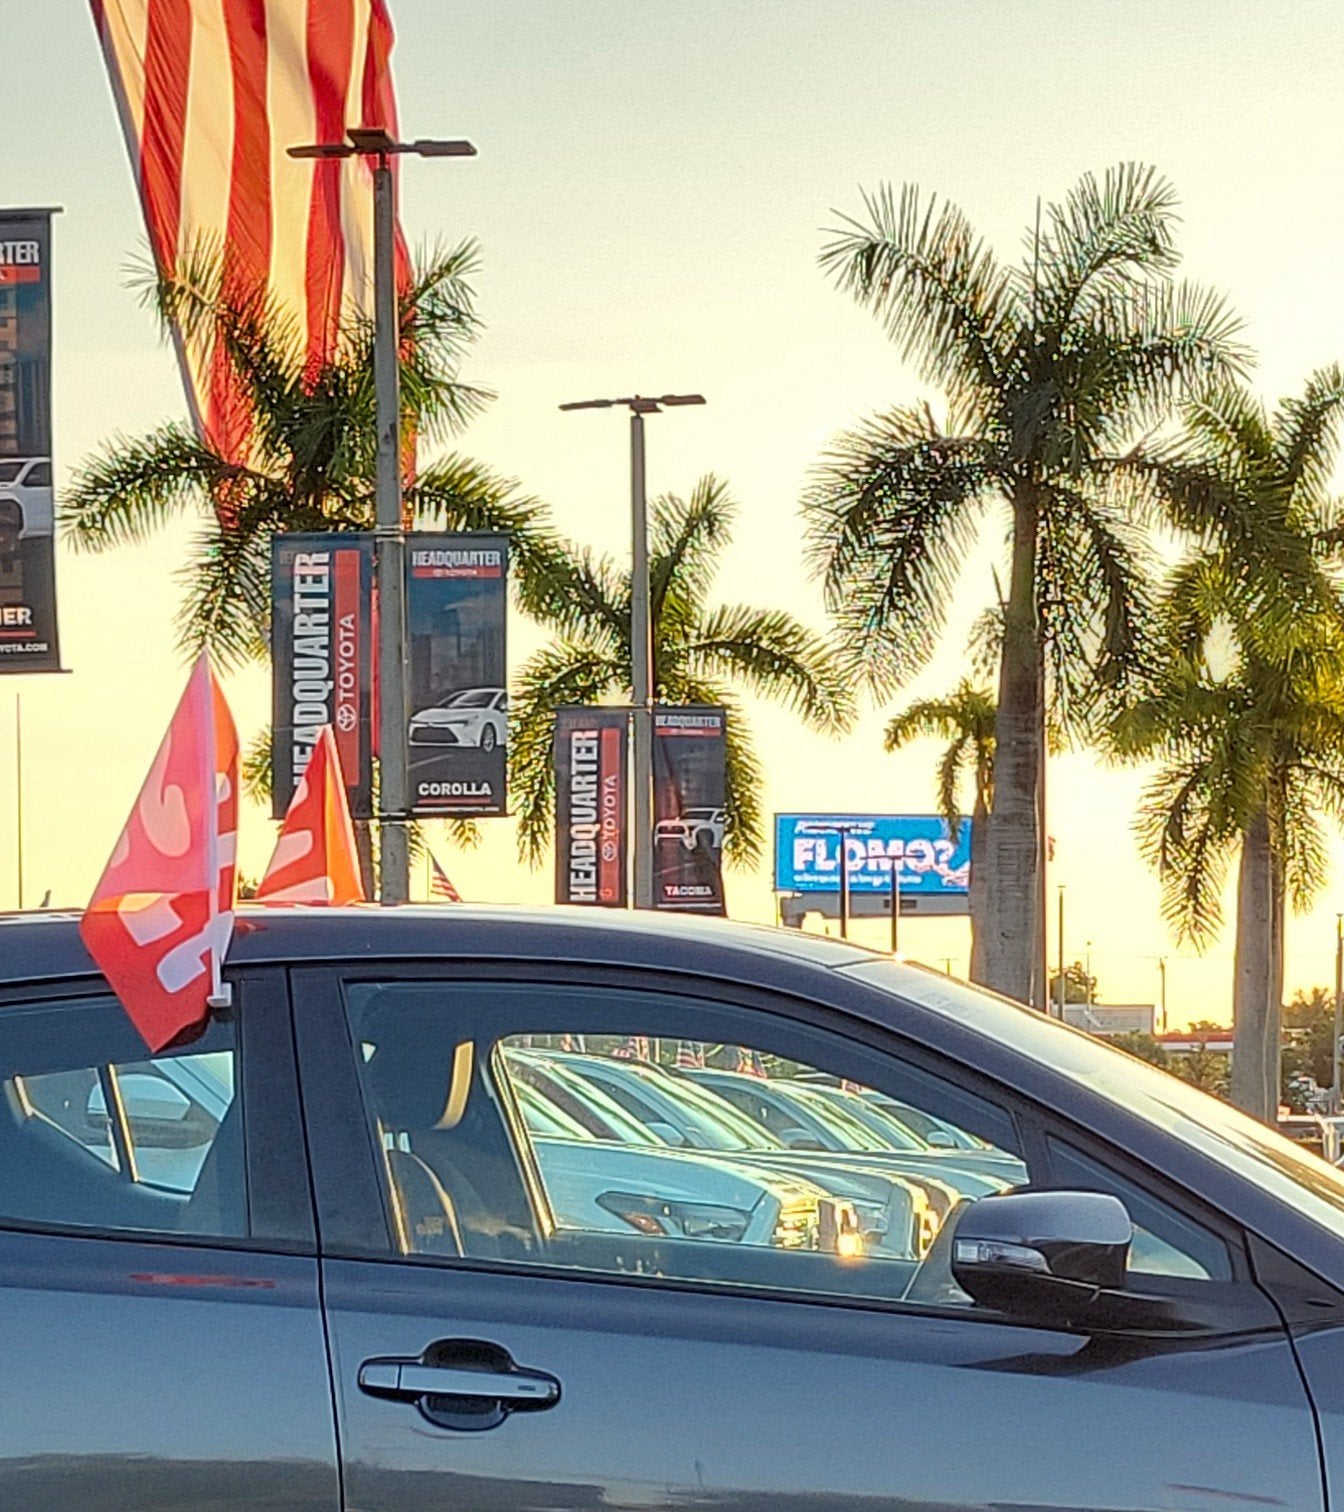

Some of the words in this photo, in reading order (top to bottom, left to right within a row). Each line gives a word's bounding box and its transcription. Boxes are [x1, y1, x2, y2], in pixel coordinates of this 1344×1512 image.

[412, 551, 501, 568] HEADQUARTER
[339, 614, 355, 705] TOYOTA
[418, 782, 492, 796] COROLLA
[603, 775, 619, 841] TOYOTA
[570, 730, 601, 901] HEADQUARTER
[665, 885, 714, 897] TACOMA
